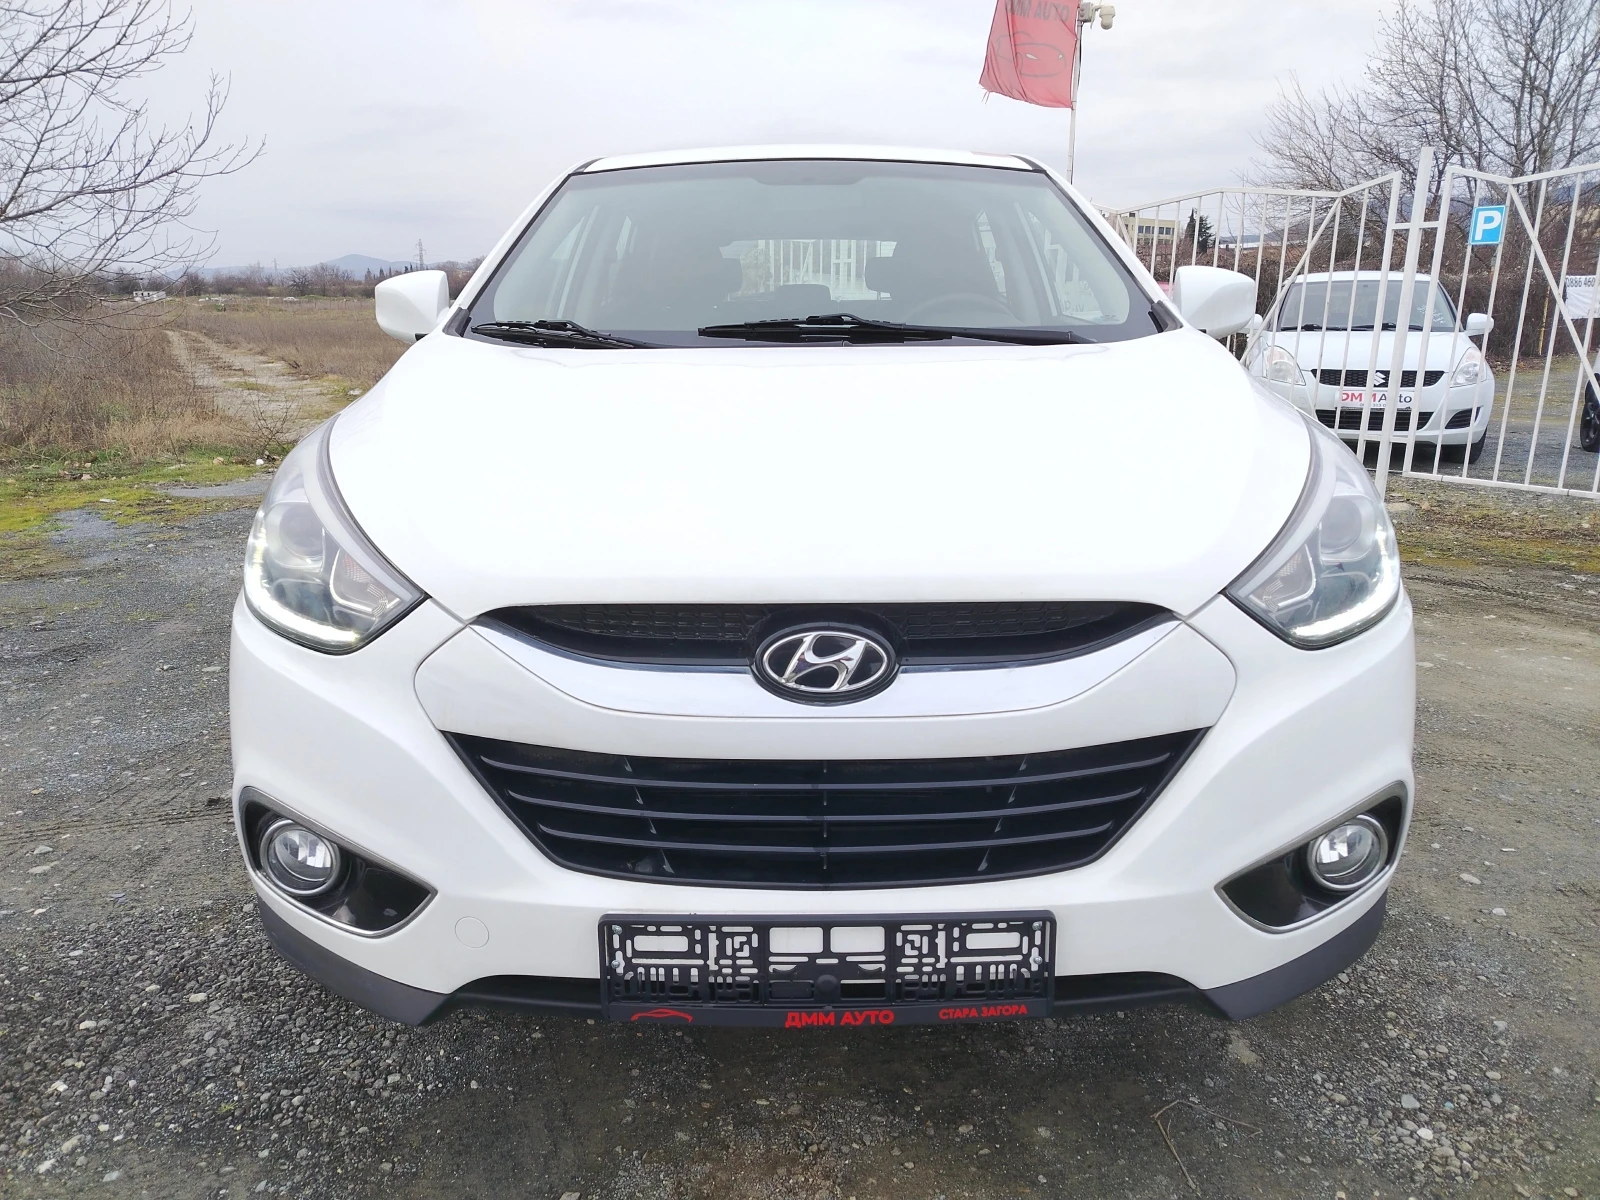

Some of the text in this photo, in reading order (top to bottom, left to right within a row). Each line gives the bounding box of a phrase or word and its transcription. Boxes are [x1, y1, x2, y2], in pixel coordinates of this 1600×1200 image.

[1034, 1, 1070, 22] AUTO
[1474, 210, 1502, 241] P
[785, 1009, 895, 1028] ДММ АУТО
[938, 1004, 1028, 1020] СТАРА ЗАГОРА
